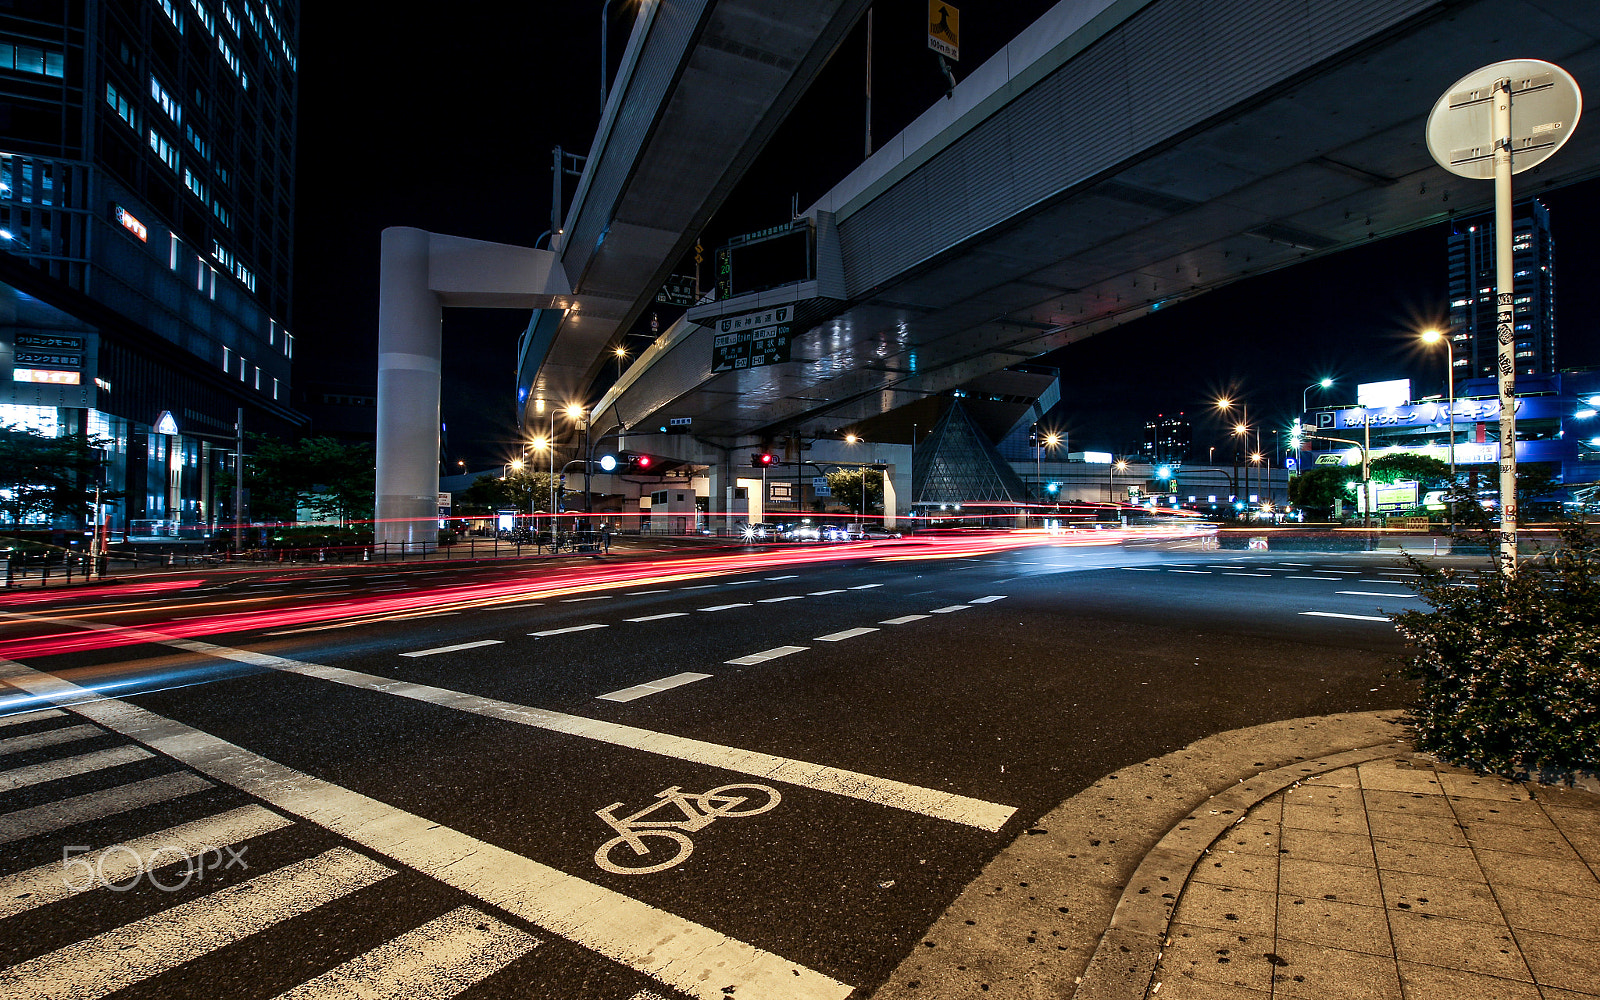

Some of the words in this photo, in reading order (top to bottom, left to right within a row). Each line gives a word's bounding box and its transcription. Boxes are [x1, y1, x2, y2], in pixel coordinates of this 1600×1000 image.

[124, 213, 147, 239] ライフ
[722, 321, 731, 331] 15
[734, 313, 772, 329] 阪神高速
[17, 336, 79, 347] クリニックモール
[16, 352, 79, 365] ジュンク堂書店
[34, 371, 77, 383] ライフ
